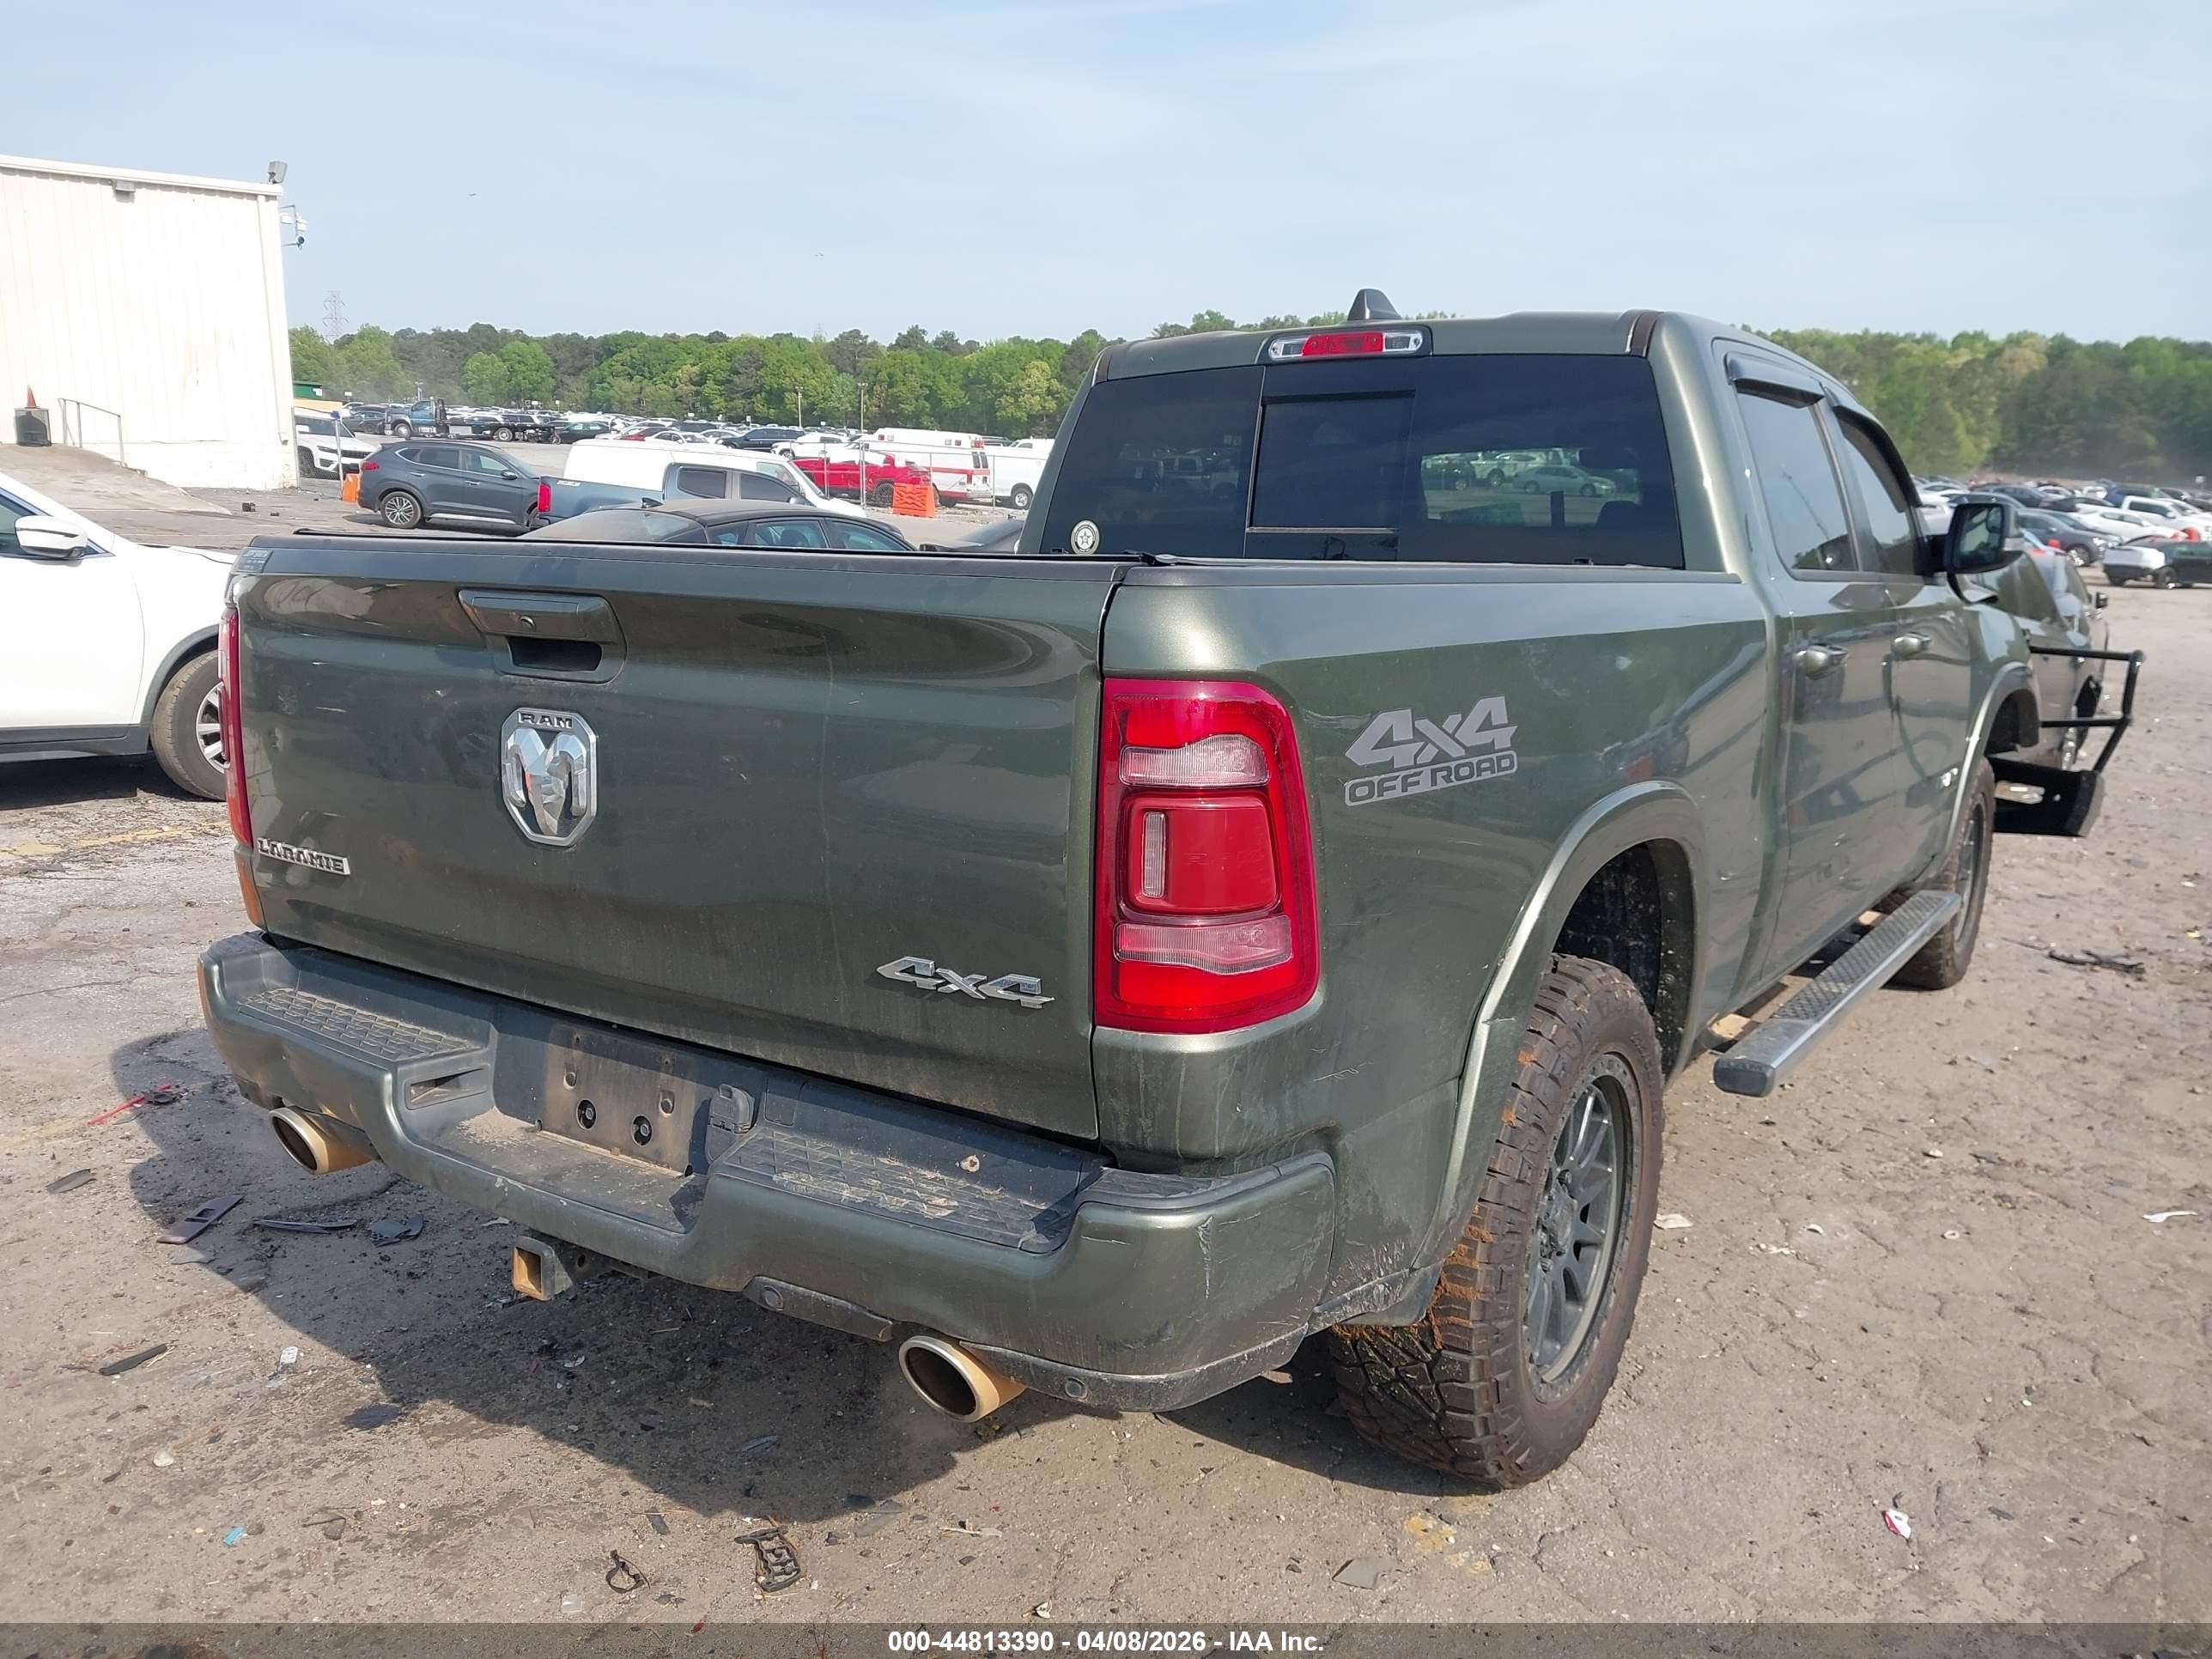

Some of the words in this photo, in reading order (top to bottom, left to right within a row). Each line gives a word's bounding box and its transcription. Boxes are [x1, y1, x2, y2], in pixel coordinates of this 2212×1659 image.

[518, 711, 573, 729] RAM
[1348, 772, 1424, 804] OFF
[1430, 752, 1516, 787] ROAD
[258, 838, 349, 874] LARAMIE
